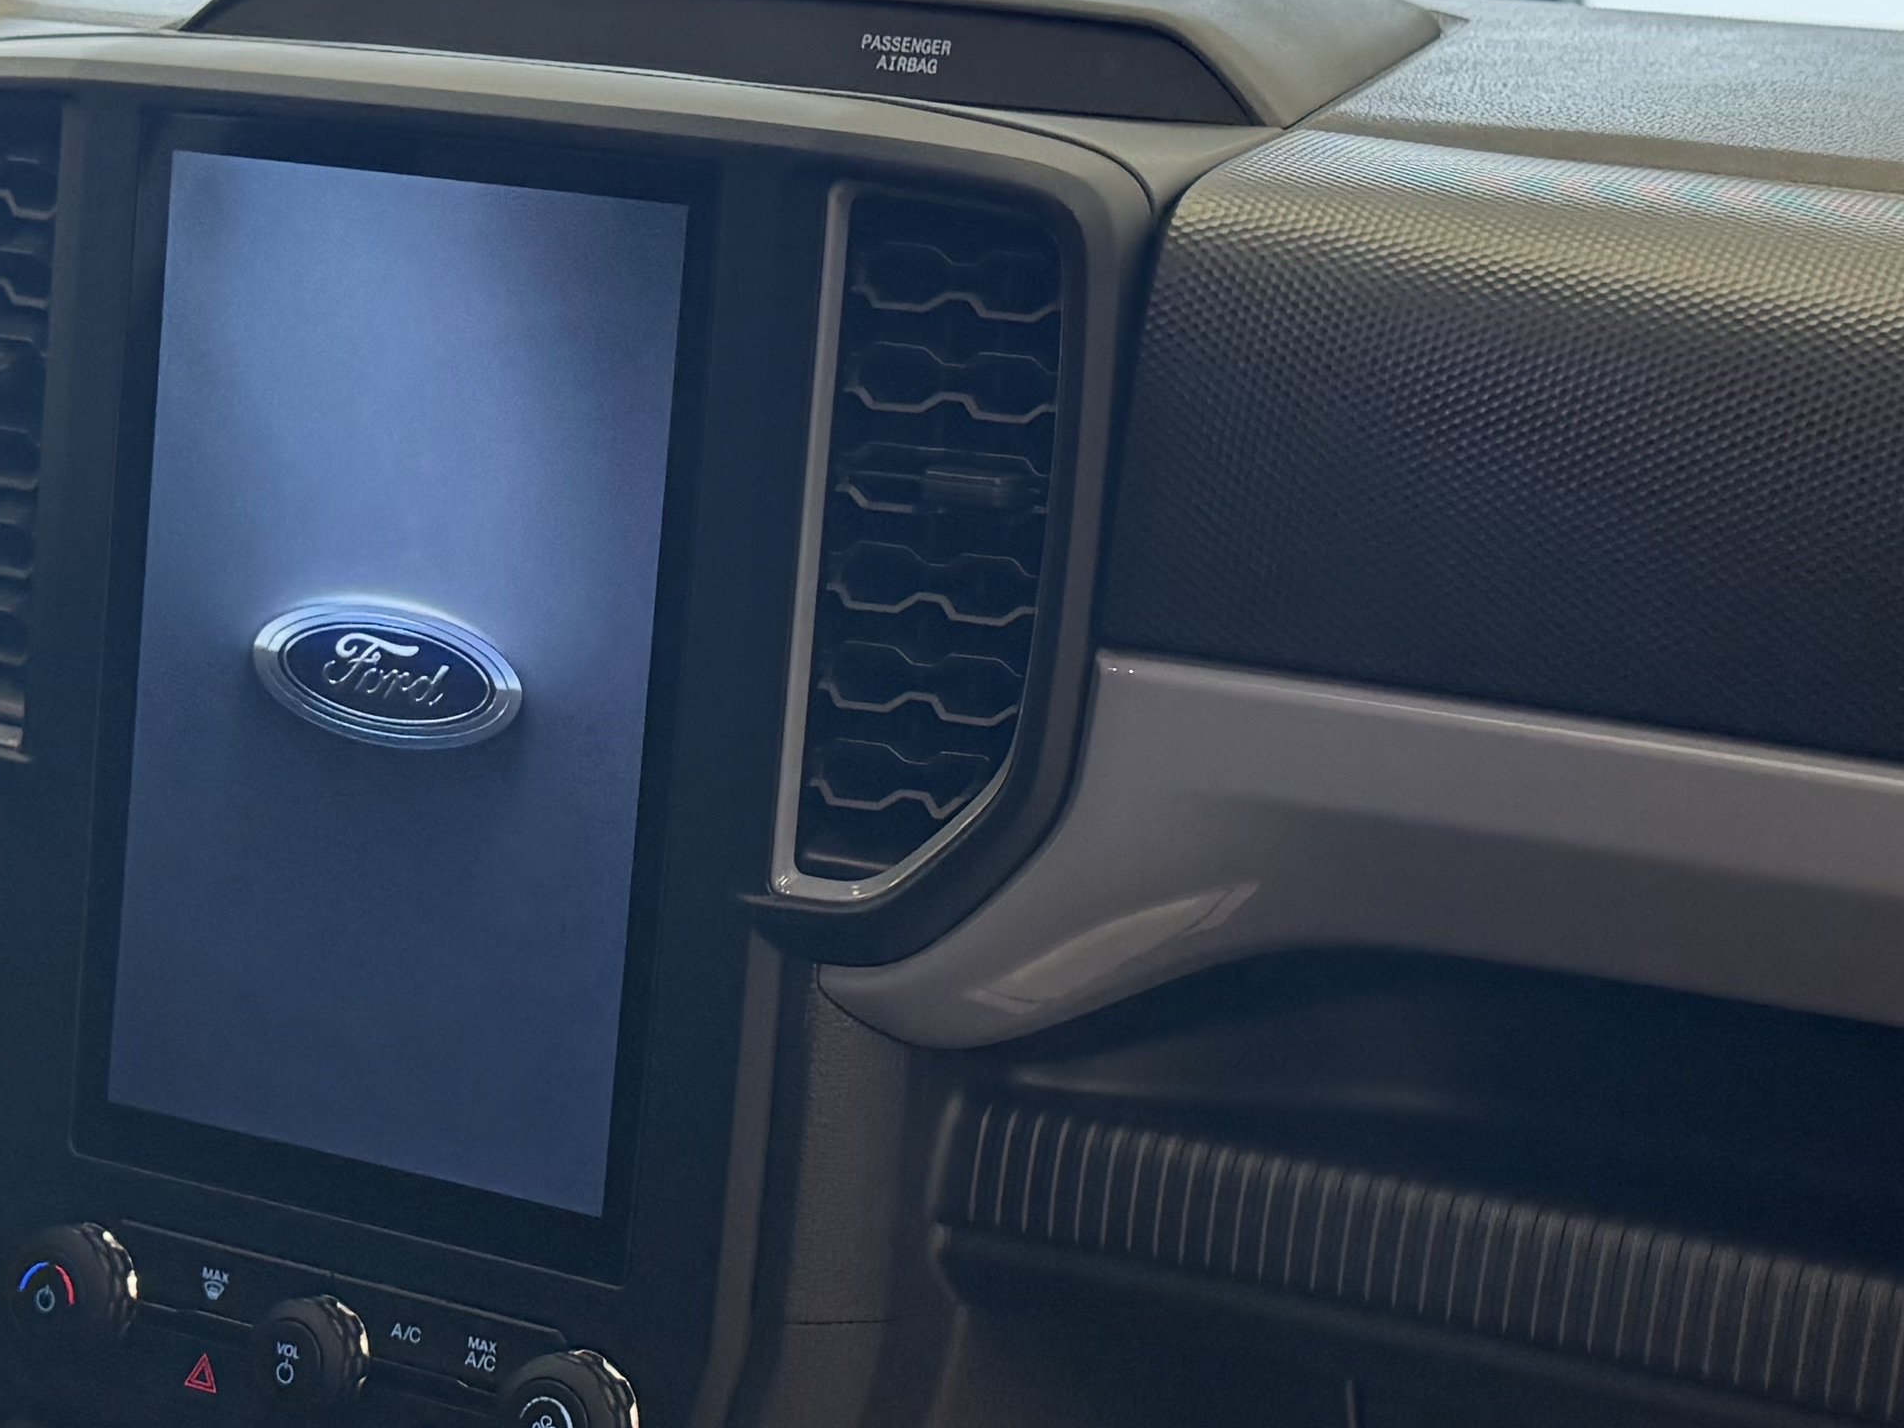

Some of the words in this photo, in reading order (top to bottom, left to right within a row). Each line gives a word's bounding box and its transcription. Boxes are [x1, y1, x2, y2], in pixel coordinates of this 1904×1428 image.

[861, 33, 952, 56] PASSENGER
[876, 55, 938, 75] AIRBAG
[322, 632, 450, 707] Ford
[201, 1266, 230, 1284] MAX
[390, 1322, 422, 1344] A/C
[276, 1341, 300, 1360] VOL
[467, 1335, 497, 1354] MAX
[464, 1351, 497, 1372] A/C
